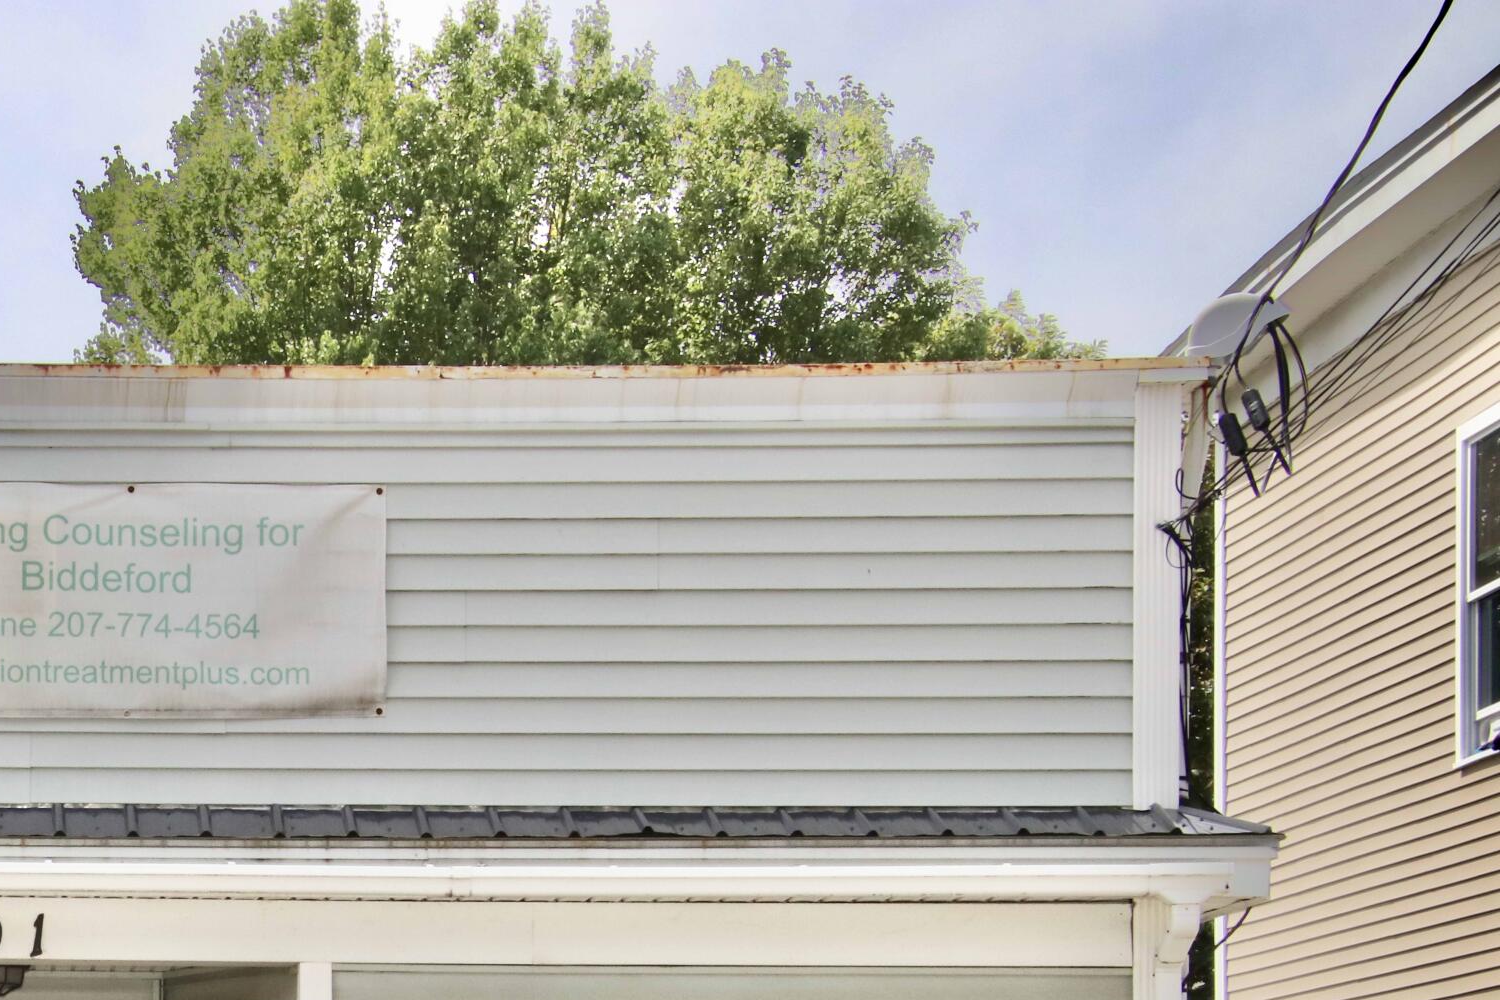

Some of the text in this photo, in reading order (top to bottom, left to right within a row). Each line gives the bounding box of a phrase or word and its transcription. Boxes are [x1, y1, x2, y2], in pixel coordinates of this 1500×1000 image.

[41, 515, 244, 555] Counseling
[256, 516, 305, 547] for
[20, 560, 192, 594] Biddeford
[47, 611, 260, 641] 207-774-4564
